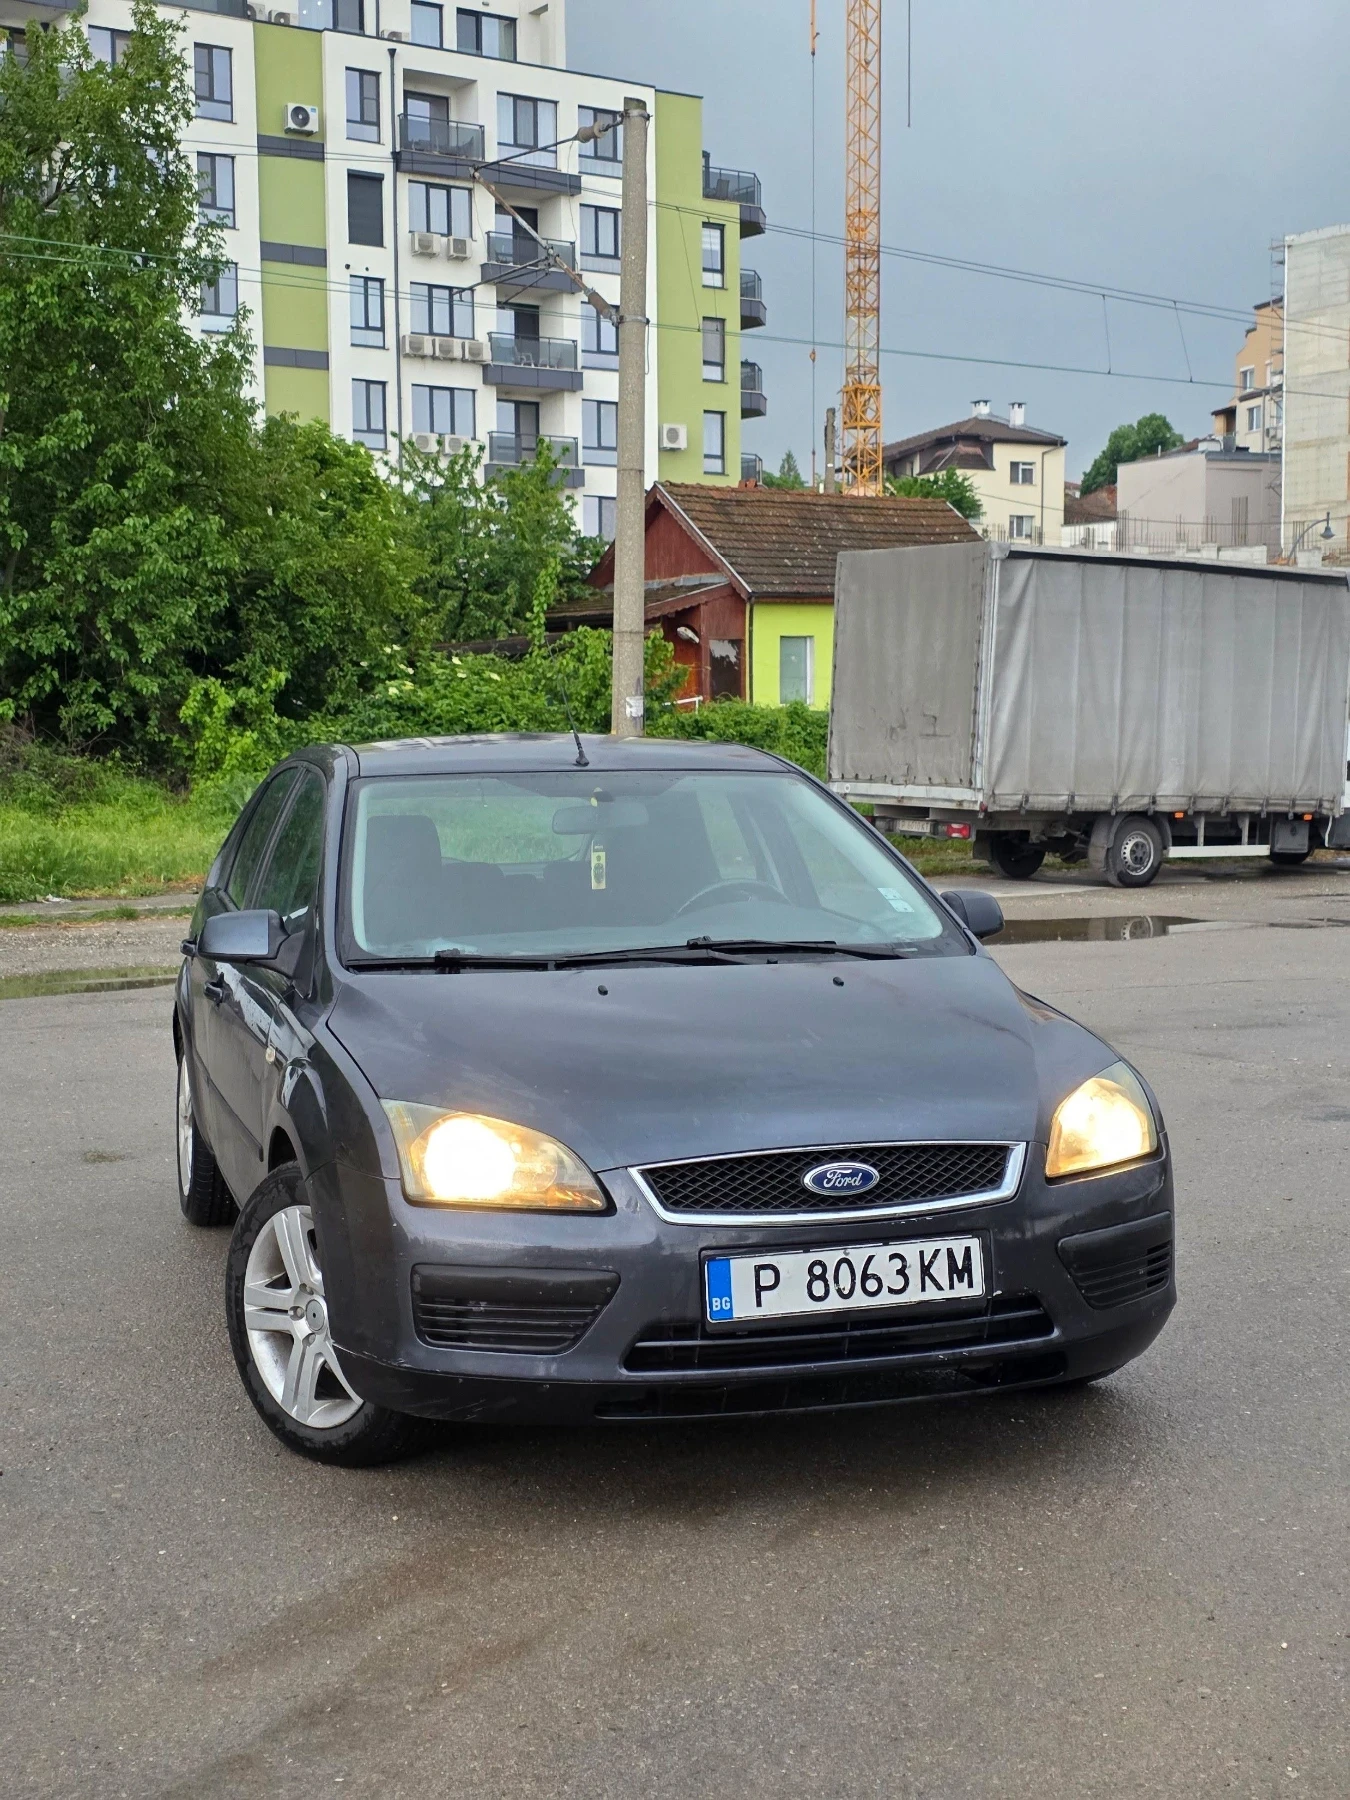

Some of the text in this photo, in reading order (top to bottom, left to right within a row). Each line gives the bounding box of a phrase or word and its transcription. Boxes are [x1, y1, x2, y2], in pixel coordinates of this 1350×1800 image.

[823, 1169, 862, 1188] Ford
[754, 1263, 780, 1307] P
[712, 1296, 731, 1311] BG
